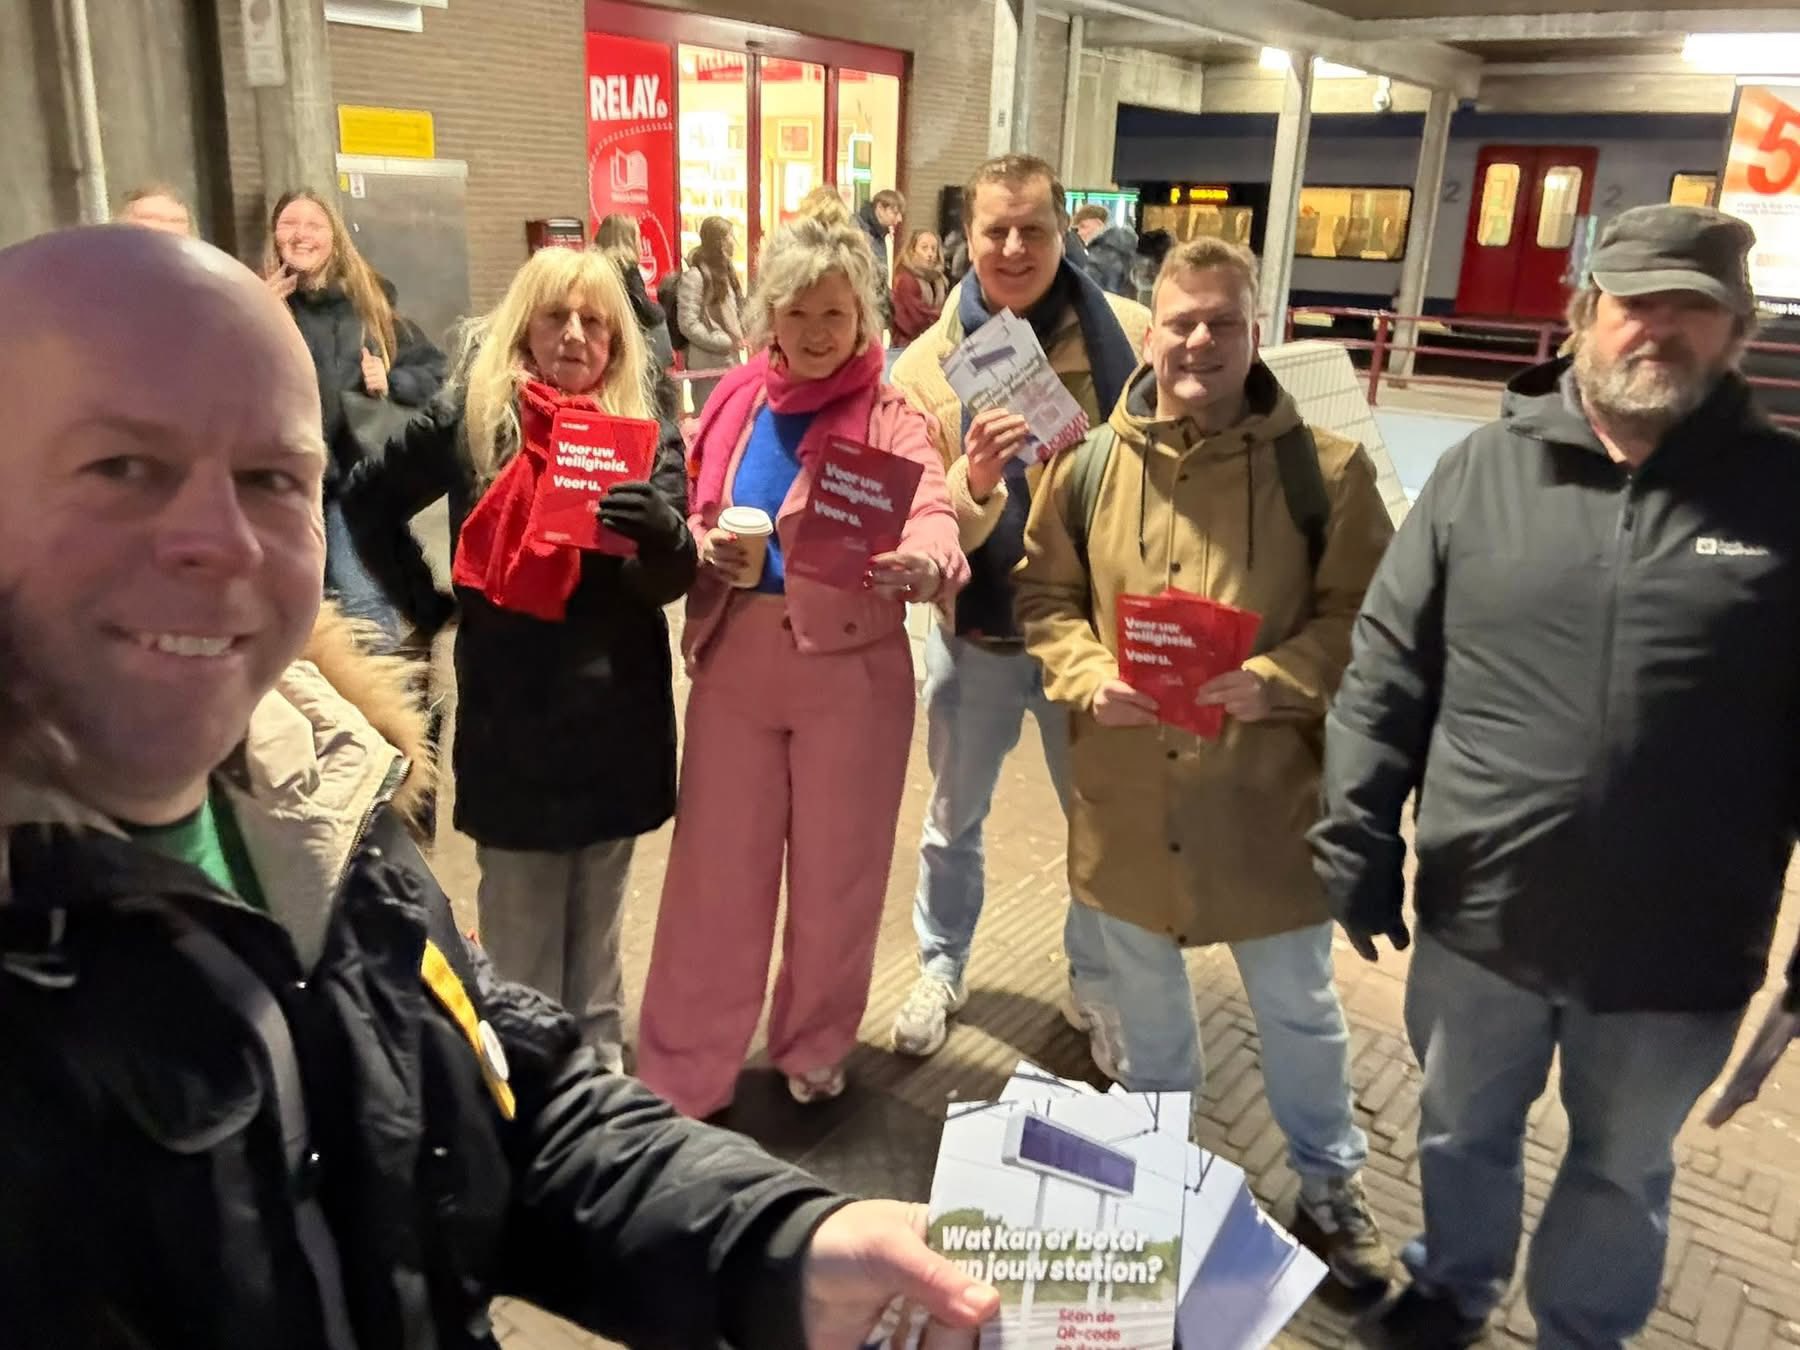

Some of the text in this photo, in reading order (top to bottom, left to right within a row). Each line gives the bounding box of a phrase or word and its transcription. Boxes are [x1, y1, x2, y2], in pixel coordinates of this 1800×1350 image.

[1443, 181, 1461, 203] 2
[1603, 184, 1622, 207] 2
[558, 441, 615, 459] Voor uw
[556, 454, 629, 473] veiligheid.
[553, 474, 602, 492] Voor u.
[1124, 616, 1181, 633] Voor uw
[1125, 629, 1197, 648] veiligheid.
[1125, 647, 1173, 666] Voor u.
[942, 1225, 1149, 1253] Wat kan er beter
[951, 1251, 1164, 1287] an jouw station?
[1058, 1307, 1115, 1323] Scan de
[1056, 1324, 1121, 1341] QR-code
